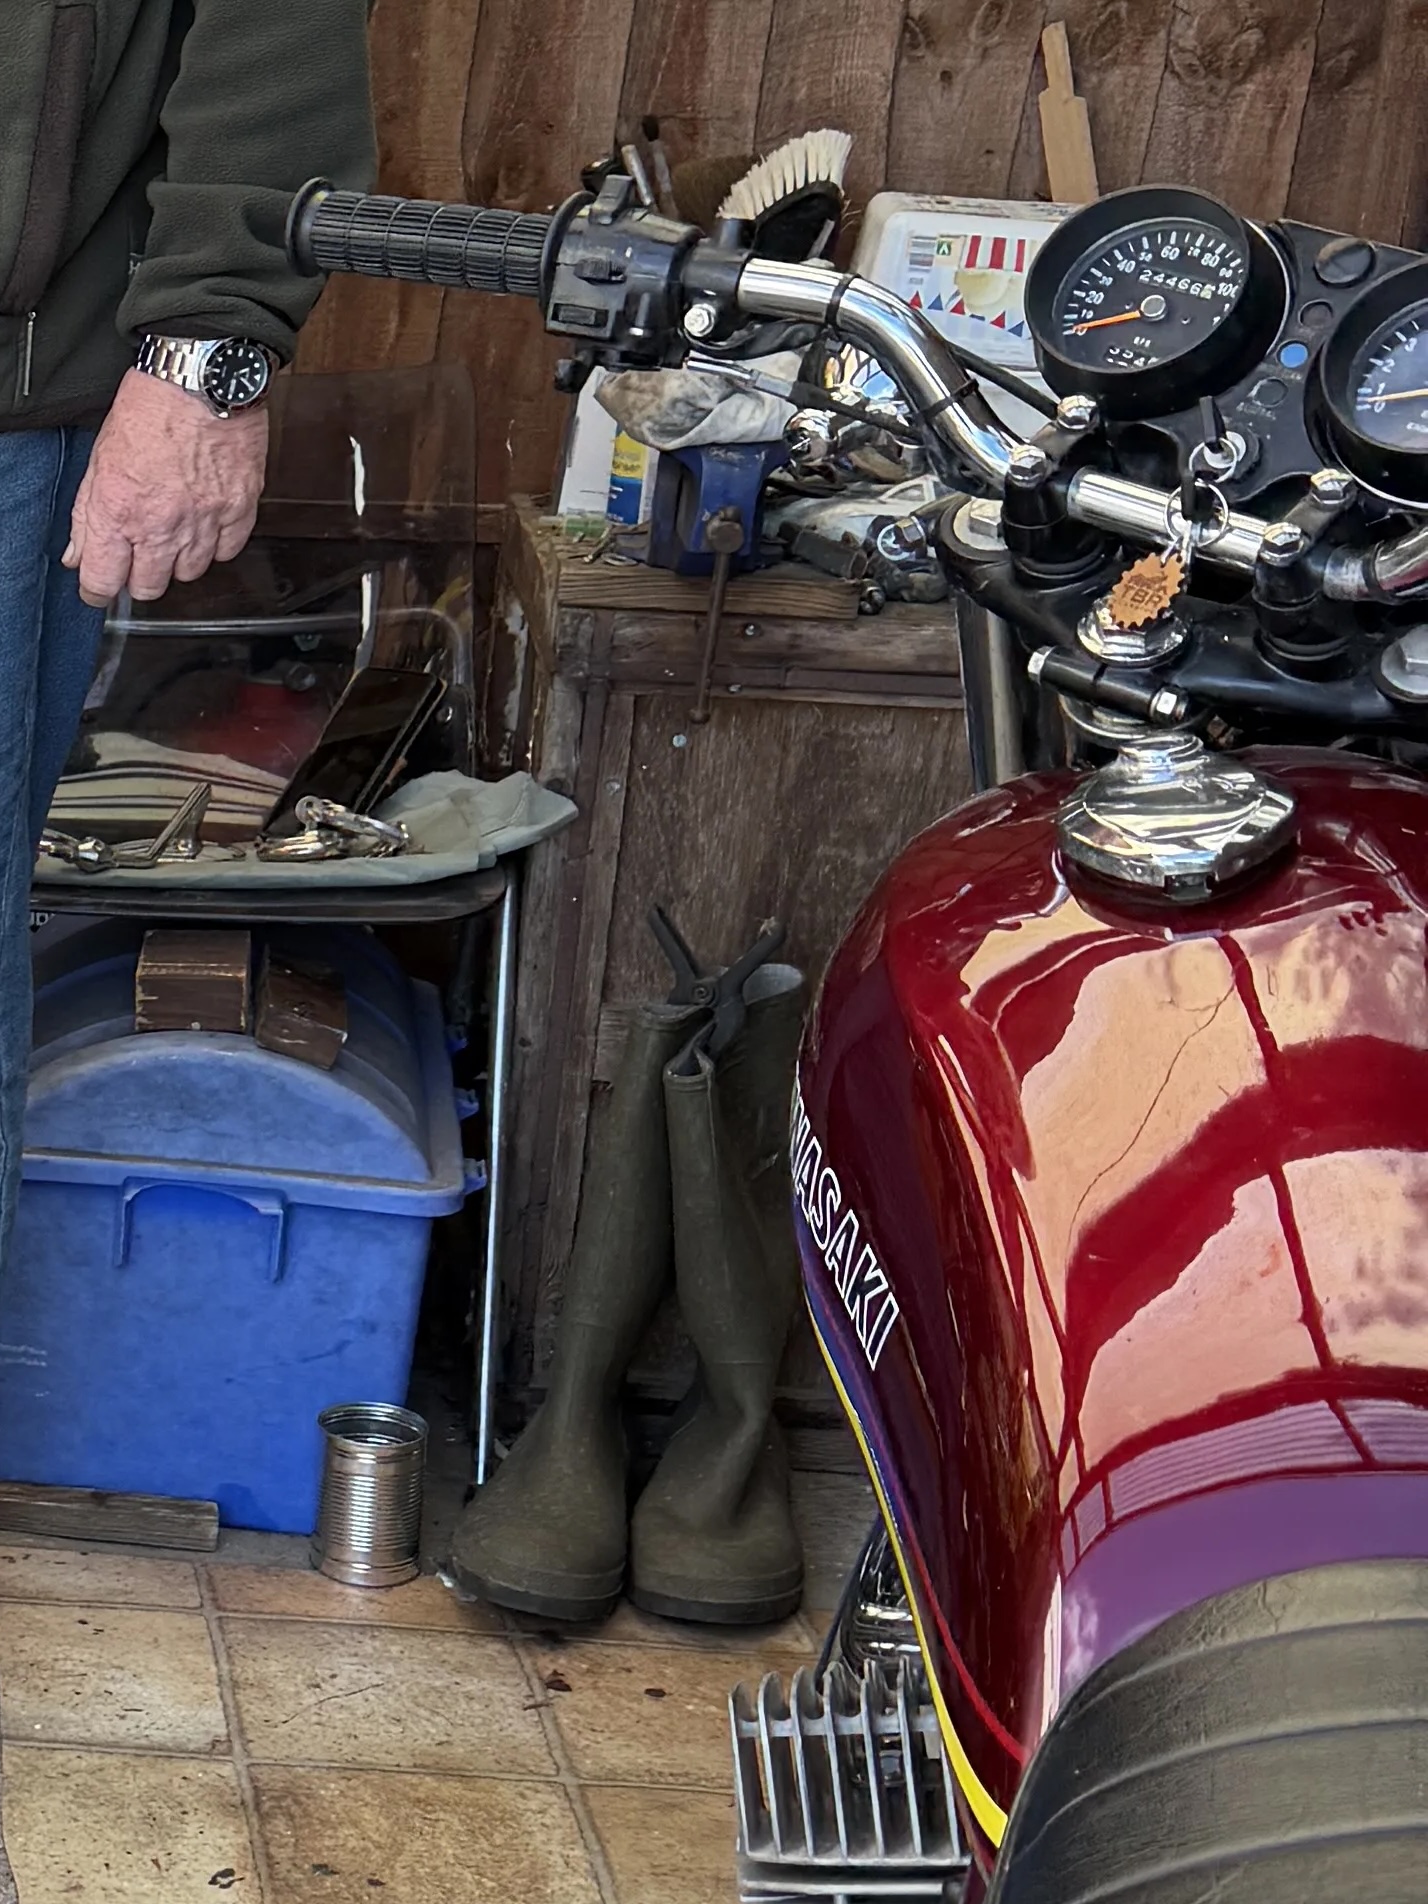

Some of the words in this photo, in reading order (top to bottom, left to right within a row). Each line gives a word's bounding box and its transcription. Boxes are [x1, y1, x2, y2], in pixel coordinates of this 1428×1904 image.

[1160, 246, 1180, 261] 60
[1200, 253, 1220, 268] 80
[1116, 259, 1136, 274] 40
[1084, 291, 1105, 305] 20
[1080, 308, 1094, 319] 10
[1404, 337, 1418, 353] 3
[1381, 358, 1396, 374] 2
[1376, 382, 1387, 396] 1
[1373, 401, 1386, 414] 0
[1121, 583, 1166, 608] TBR
[790, 1091, 900, 1372] WASAKI
